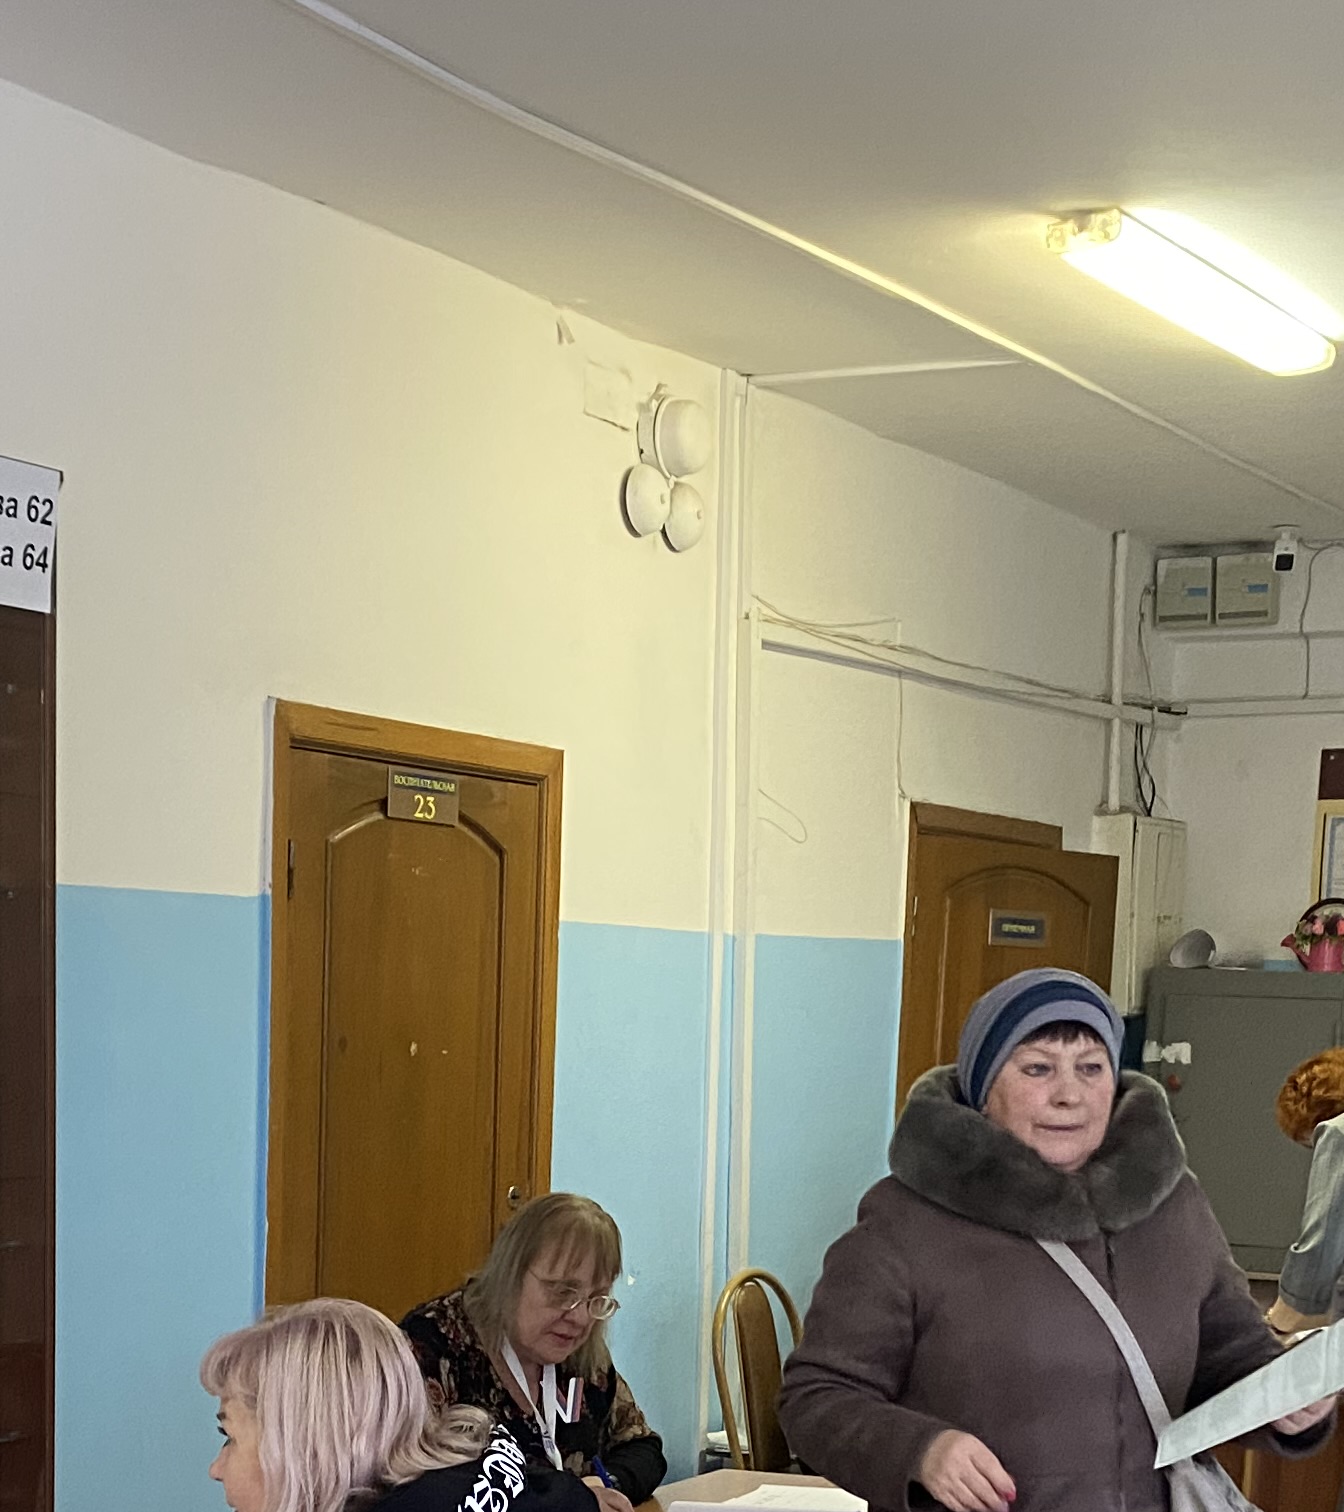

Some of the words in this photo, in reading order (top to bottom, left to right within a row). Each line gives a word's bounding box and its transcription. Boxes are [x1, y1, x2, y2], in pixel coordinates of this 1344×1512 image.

[26, 495, 54, 526] 62
[22, 543, 49, 574] 64
[413, 794, 436, 820] 23
